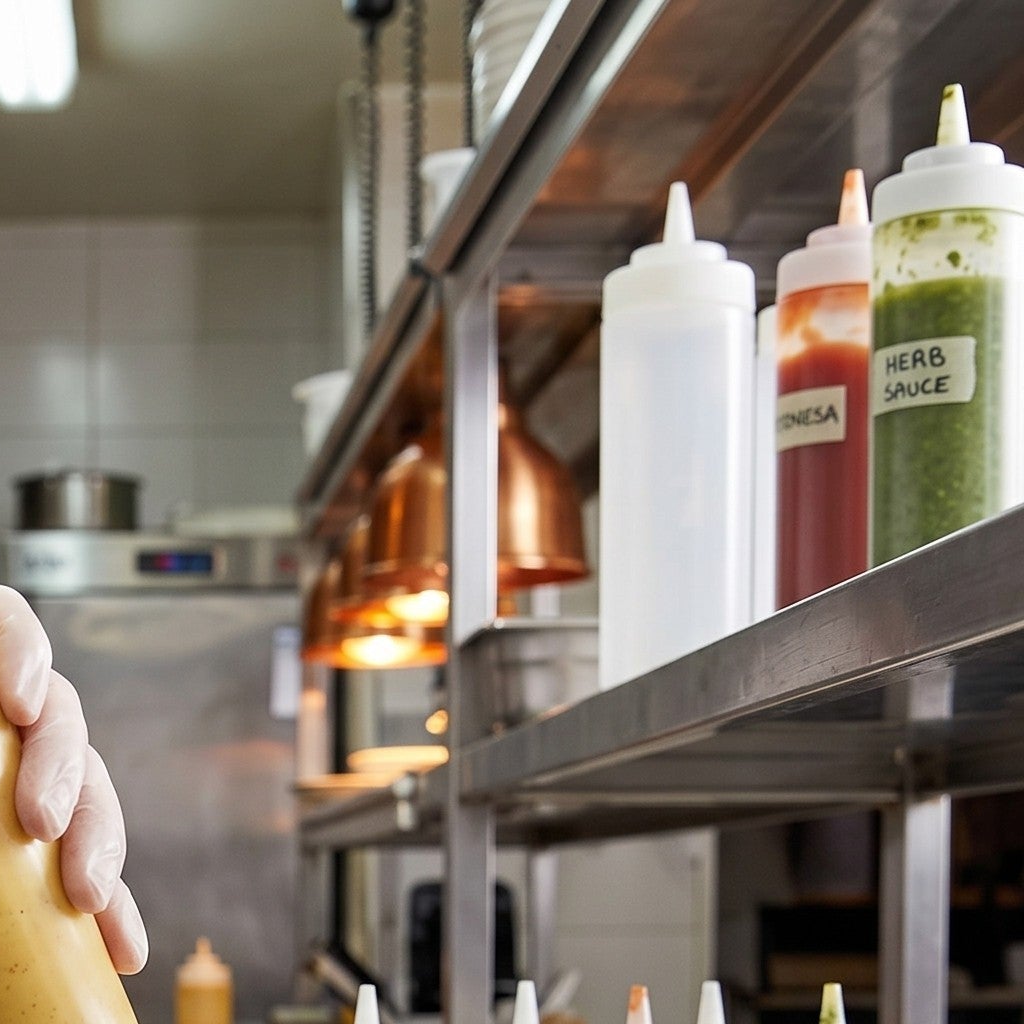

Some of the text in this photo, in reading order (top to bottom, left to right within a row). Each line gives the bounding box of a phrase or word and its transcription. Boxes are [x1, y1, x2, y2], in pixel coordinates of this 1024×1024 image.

[885, 346, 946, 375] HERB
[884, 374, 950, 402] SAUCE
[778, 404, 839, 431] ONESA
